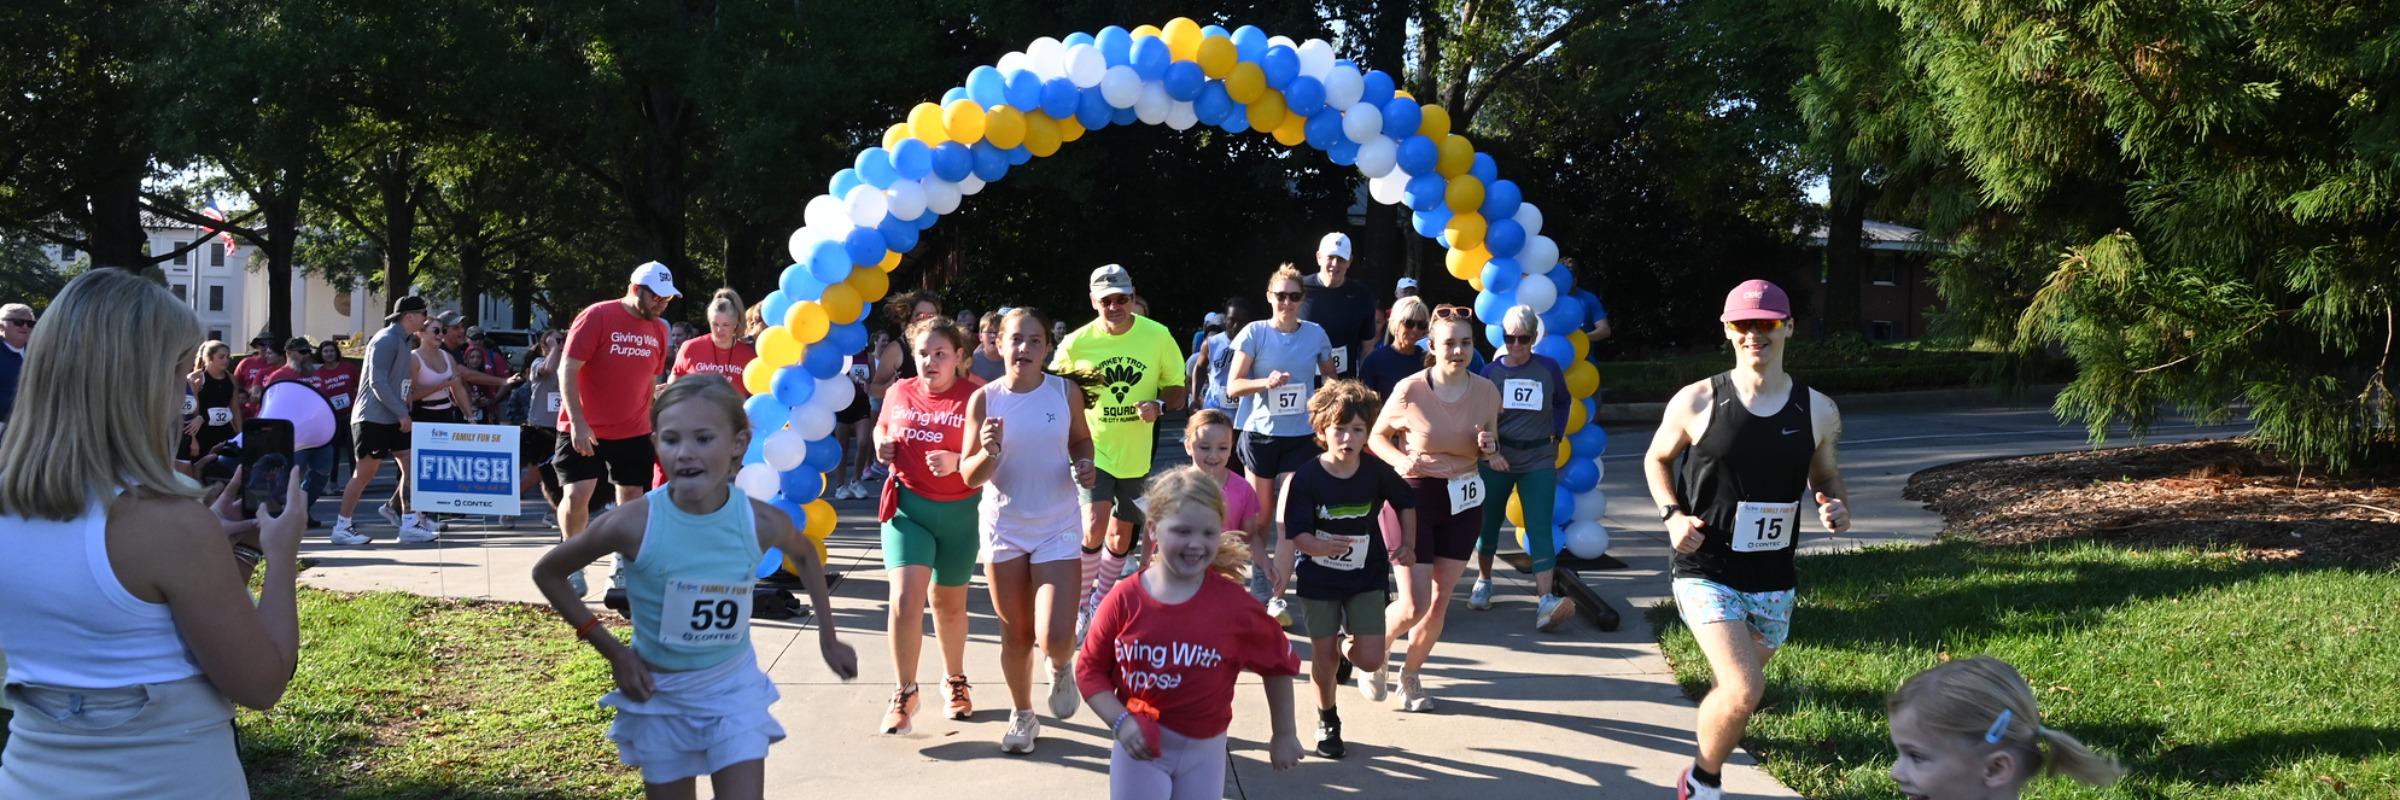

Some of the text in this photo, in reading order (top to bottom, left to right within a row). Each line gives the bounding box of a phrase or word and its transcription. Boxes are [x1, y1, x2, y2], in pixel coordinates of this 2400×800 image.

[610, 332, 643, 346] Giving
[610, 344, 652, 358] Purpose
[696, 362, 724, 374] Giving
[1126, 356, 1147, 371] TROT
[1279, 392, 1298, 408] 57
[1514, 387, 1534, 402] 67
[215, 412, 227, 422] 32
[892, 404, 932, 427] Giving
[1103, 406, 1137, 417] SQUAD
[451, 432, 476, 441] FAMILY
[476, 433, 490, 442] FUN
[490, 434, 502, 443] 5K
[420, 454, 510, 484] FINISH
[1460, 481, 1478, 502] 16
[462, 500, 494, 508] CONTEC
[1755, 517, 1784, 541] 15
[700, 585, 731, 594] FAMILY
[690, 600, 739, 631] 59
[694, 632, 738, 641] CONTEC
[1172, 641, 1222, 669] With
